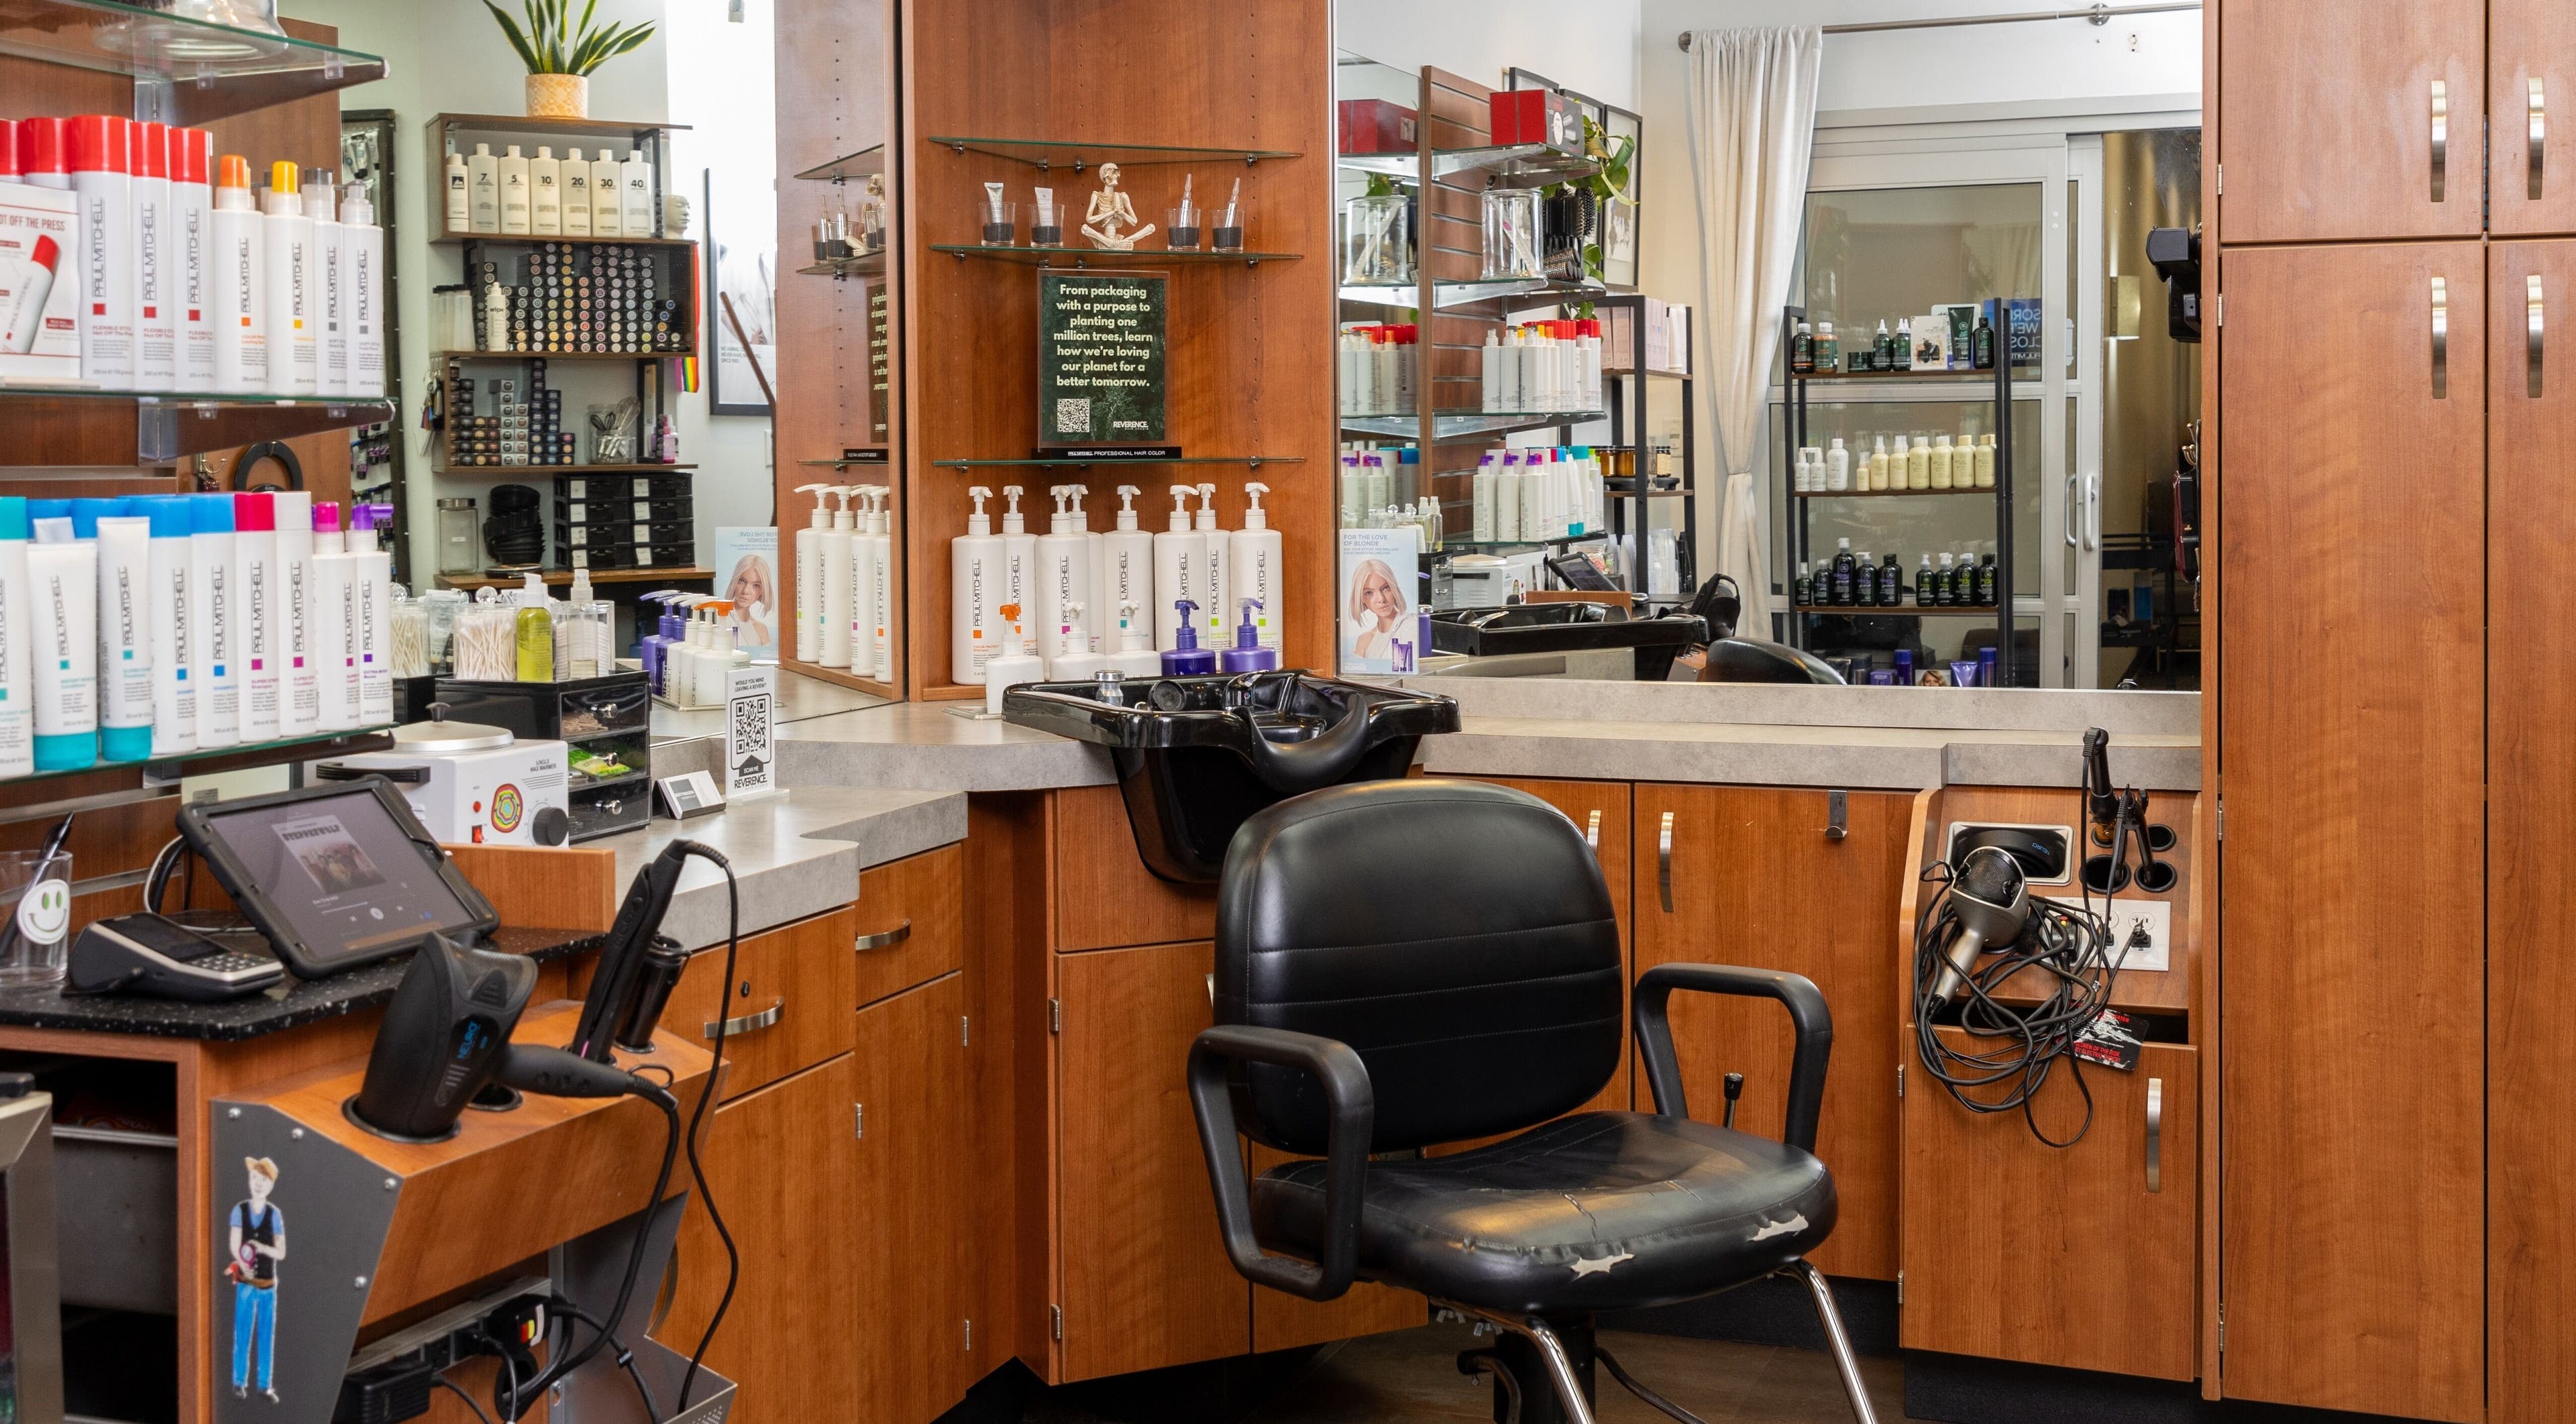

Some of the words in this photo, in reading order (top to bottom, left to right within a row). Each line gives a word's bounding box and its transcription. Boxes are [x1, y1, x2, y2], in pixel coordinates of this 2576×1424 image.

[481, 173, 487, 181] 7
[541, 176, 551, 184] 10
[572, 177, 584, 185] 20
[600, 179, 613, 187] 30
[631, 180, 643, 188] 40
[10, 215, 23, 227] OFF
[26, 217, 40, 229] THE
[42, 219, 65, 231] PRESS
[93, 199, 103, 262] MITCHELL
[145, 205, 154, 267] MITCHELL
[189, 210, 197, 269] MITCHELL
[94, 264, 104, 297] PAUL
[146, 269, 154, 300] PAUL
[190, 272, 198, 303] PAUL
[1060, 284, 1088, 295] From
[1091, 286, 1146, 299] packaging
[1057, 300, 1081, 311] with
[1093, 303, 1136, 313] purpose
[1139, 303, 1150, 311] to
[1071, 315, 1115, 329] planting
[1054, 330, 1090, 341] million
[1092, 331, 1122, 343] trees,
[1125, 331, 1153, 342] learn
[1057, 345, 1081, 355] how
[1116, 345, 1150, 359] loving
[1057, 376, 1089, 386] better
[1092, 377, 1150, 387] tomorrow.
[1062, 363, 1081, 371] our
[1083, 360, 1118, 373] planet
[1120, 361, 1136, 371] for
[1138, 364, 1145, 372] a
[52, 576, 65, 624] MITCHELL
[120, 568, 131, 617] MITCHELL
[176, 568, 184, 629] MITCHELL
[214, 565, 223, 626] MITCHELL
[253, 561, 262, 620] MITCHELL
[293, 561, 302, 620] MITCHELL
[59, 625, 68, 656] PAUL
[123, 618, 132, 646] PAUL
[178, 632, 186, 663] PAUL
[215, 628, 223, 659] PAUL
[254, 622, 262, 653] PAUL
[294, 621, 303, 652] PAUL
[2032, 842, 2050, 856] NEURO
[457, 1021, 479, 1059] NEURO
[2082, 1048, 2102, 1059] ELECTRIC
